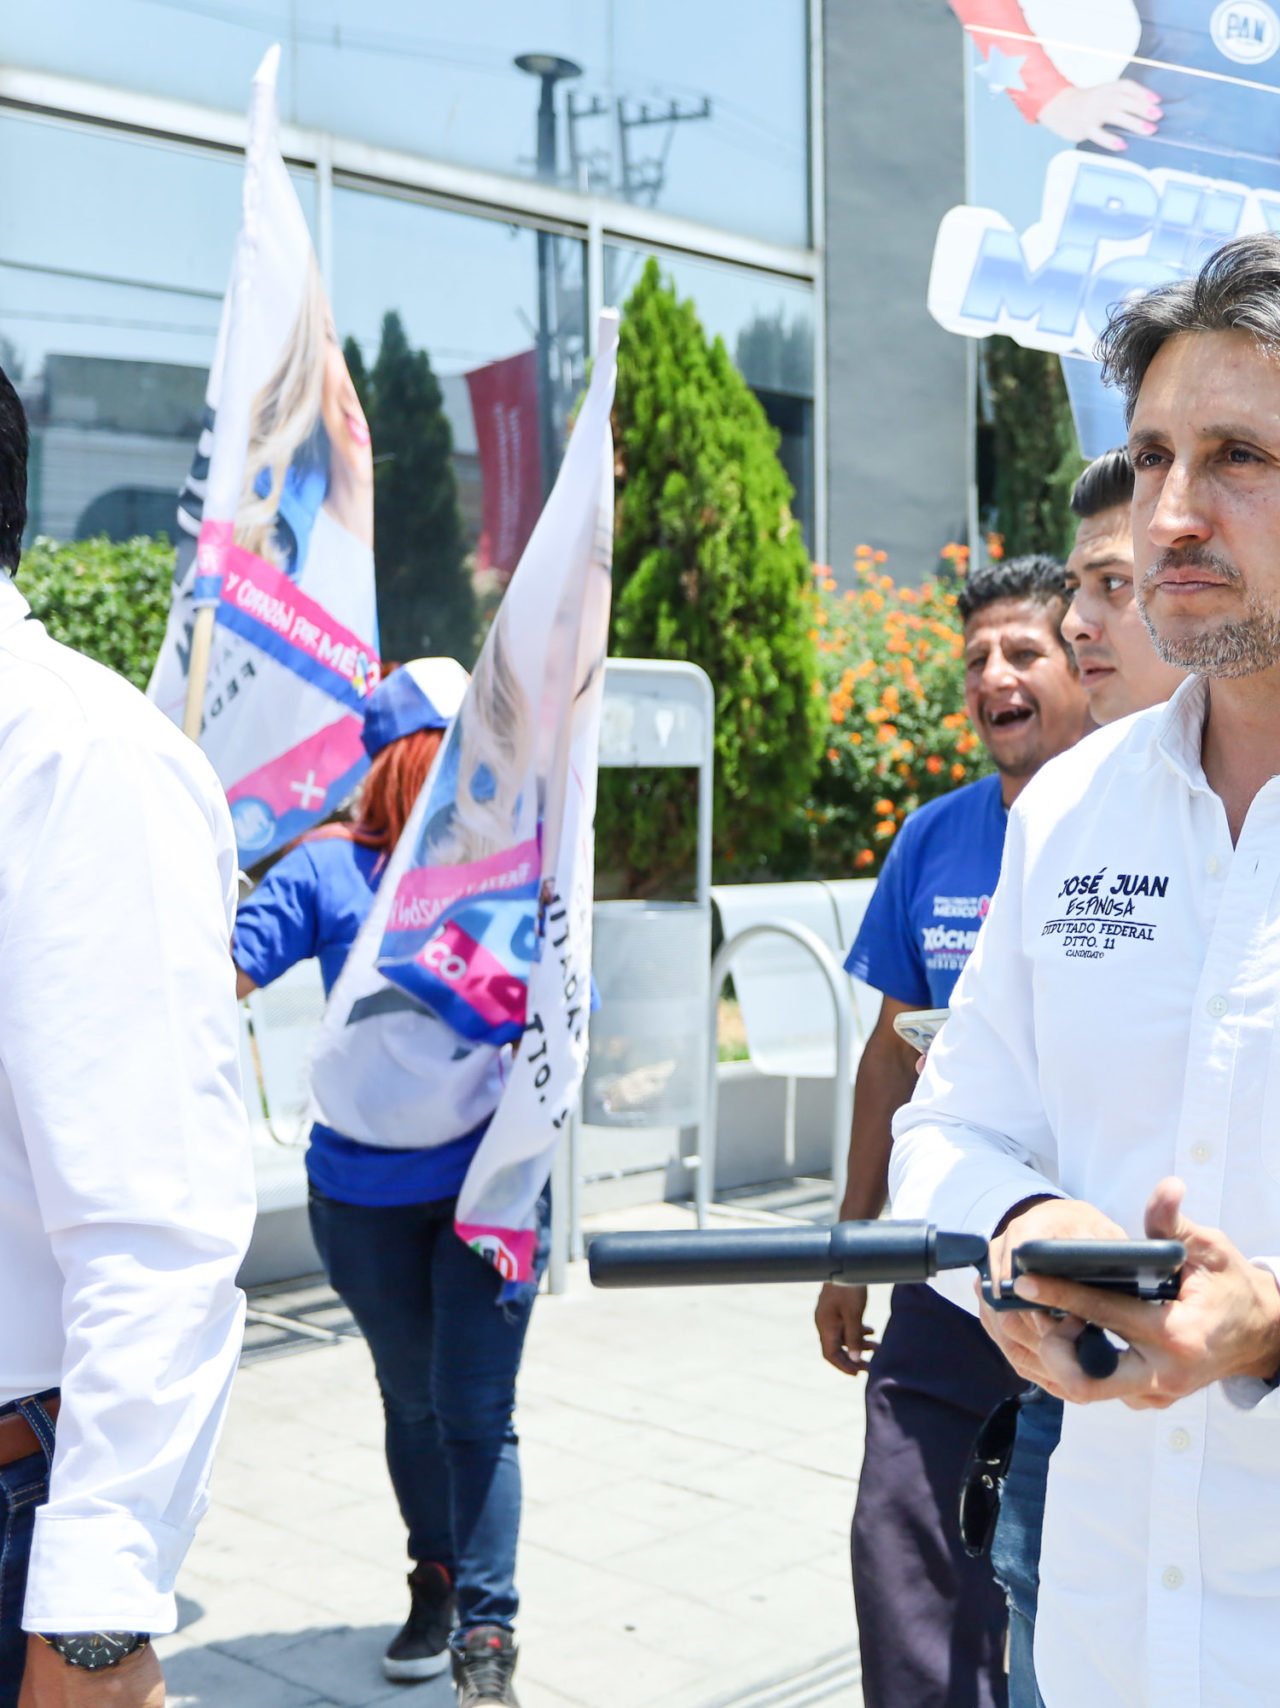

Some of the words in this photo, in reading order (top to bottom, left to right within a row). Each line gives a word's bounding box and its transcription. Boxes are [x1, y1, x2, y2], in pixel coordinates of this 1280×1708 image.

[1224, 13, 1266, 43] PAN
[1058, 867, 1108, 898] JOSÉ
[1110, 874, 1169, 897] JUAN
[1066, 895, 1135, 917] ESPINOSA
[1041, 922, 1095, 936] DIPUTADO
[1098, 923, 1155, 941] FEDERAL
[1062, 936, 1098, 948] DTTO.
[1103, 938, 1115, 949] 11
[1065, 950, 1104, 959] CANDIDATO
